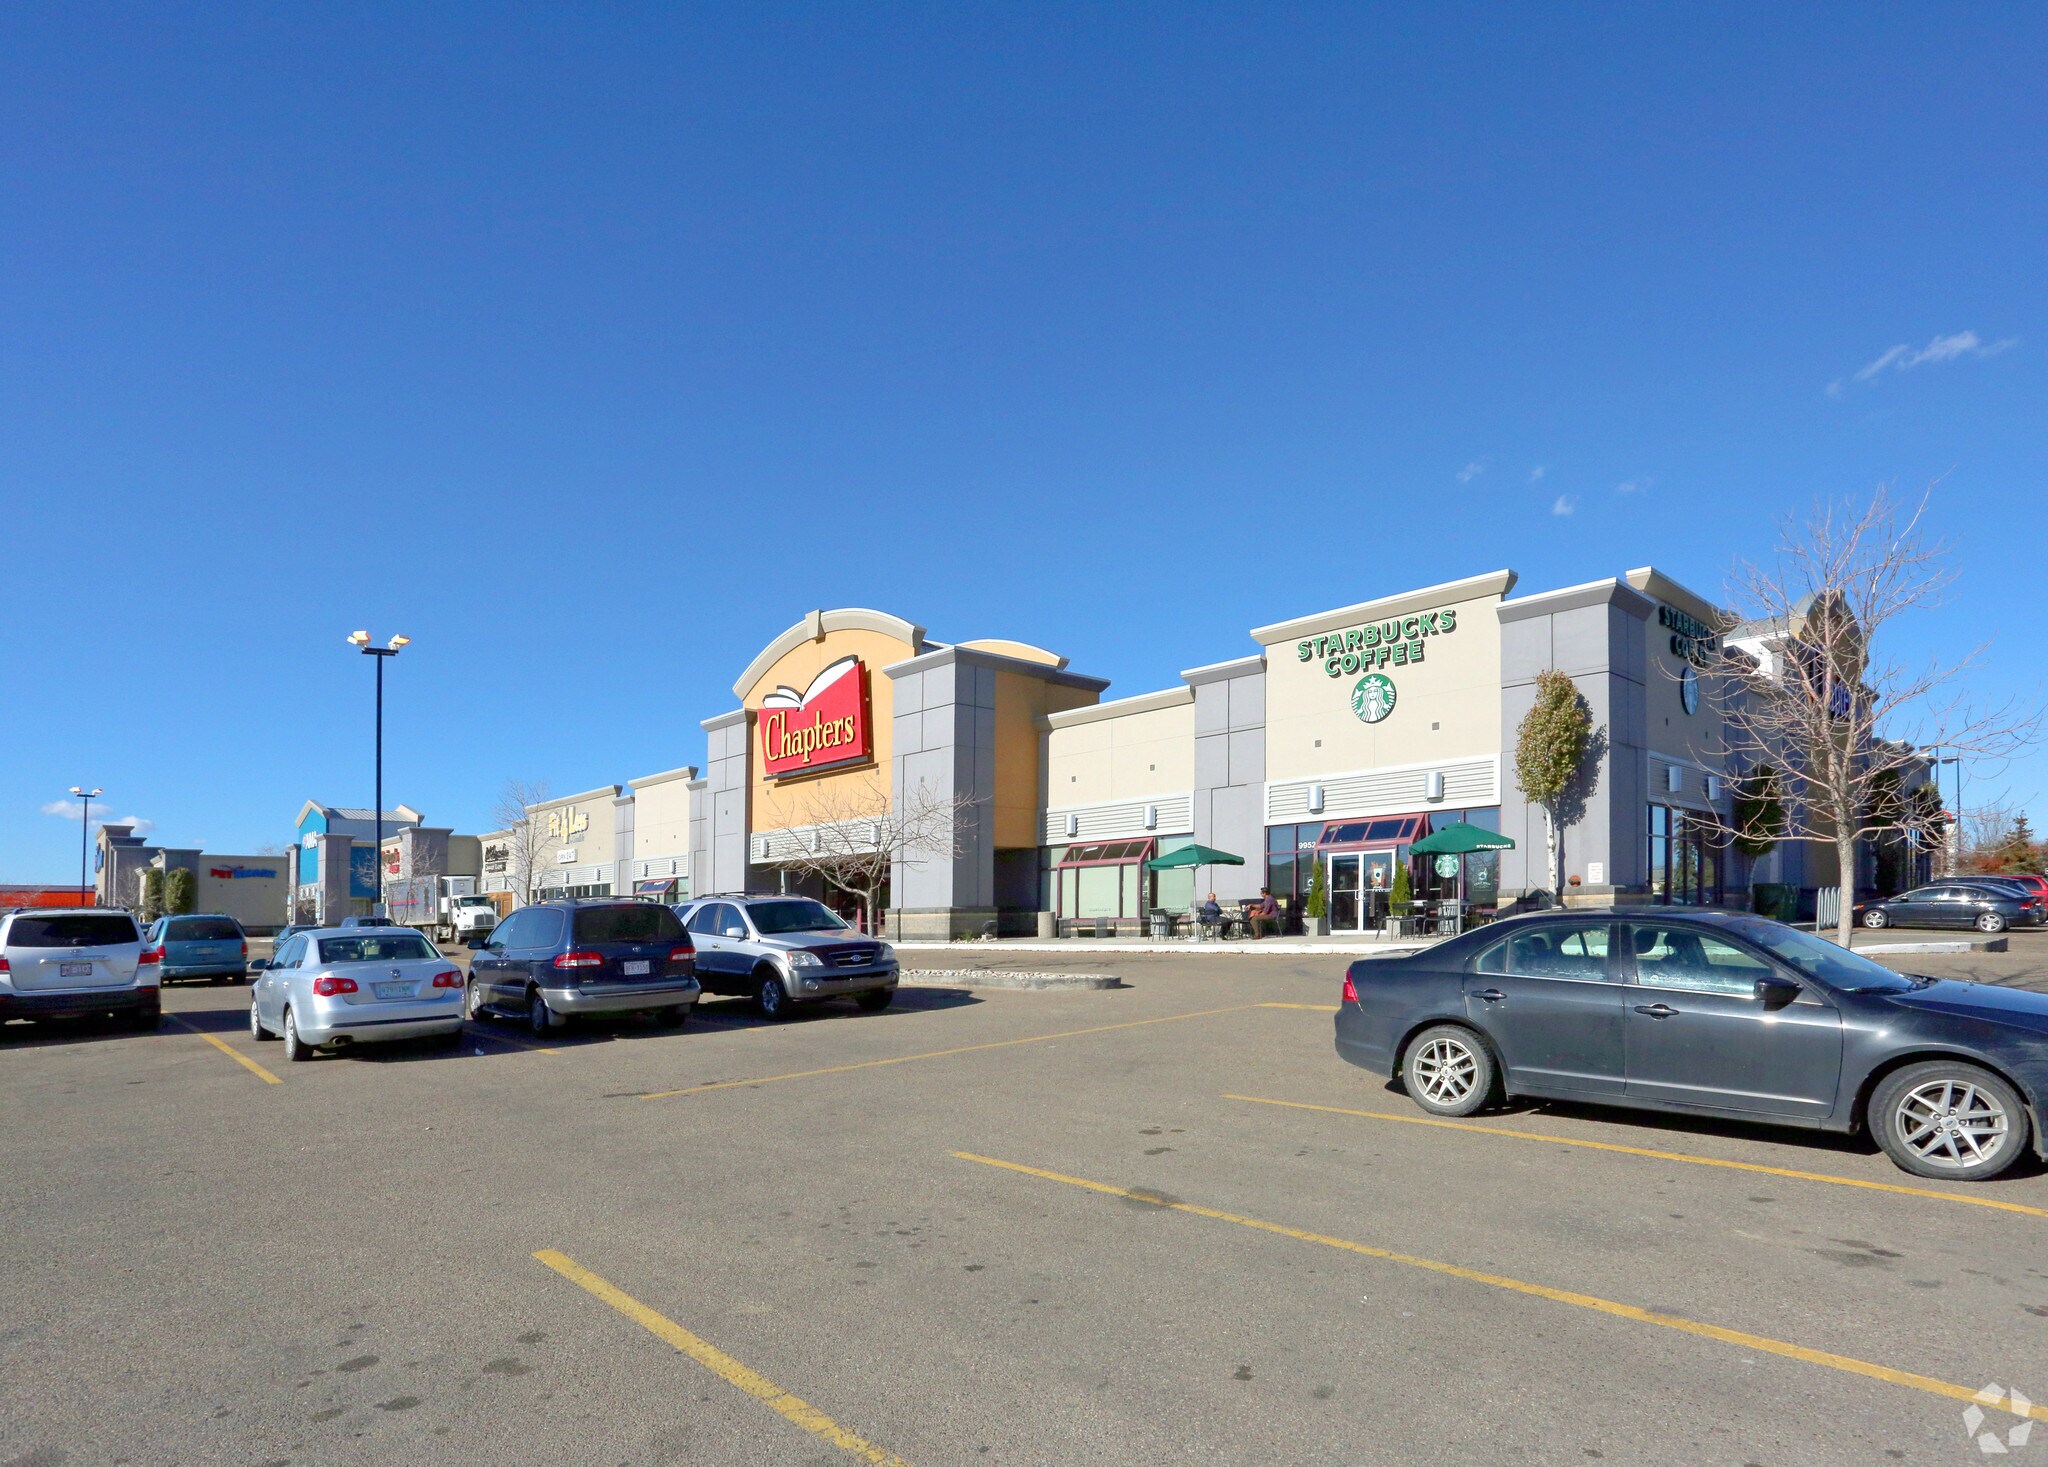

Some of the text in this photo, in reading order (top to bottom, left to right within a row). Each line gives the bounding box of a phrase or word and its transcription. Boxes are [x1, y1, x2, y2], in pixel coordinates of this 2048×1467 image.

[1297, 609, 1457, 662] STARBUCKS
[1324, 639, 1425, 678] COFFEE
[765, 710, 855, 763] Chapters
